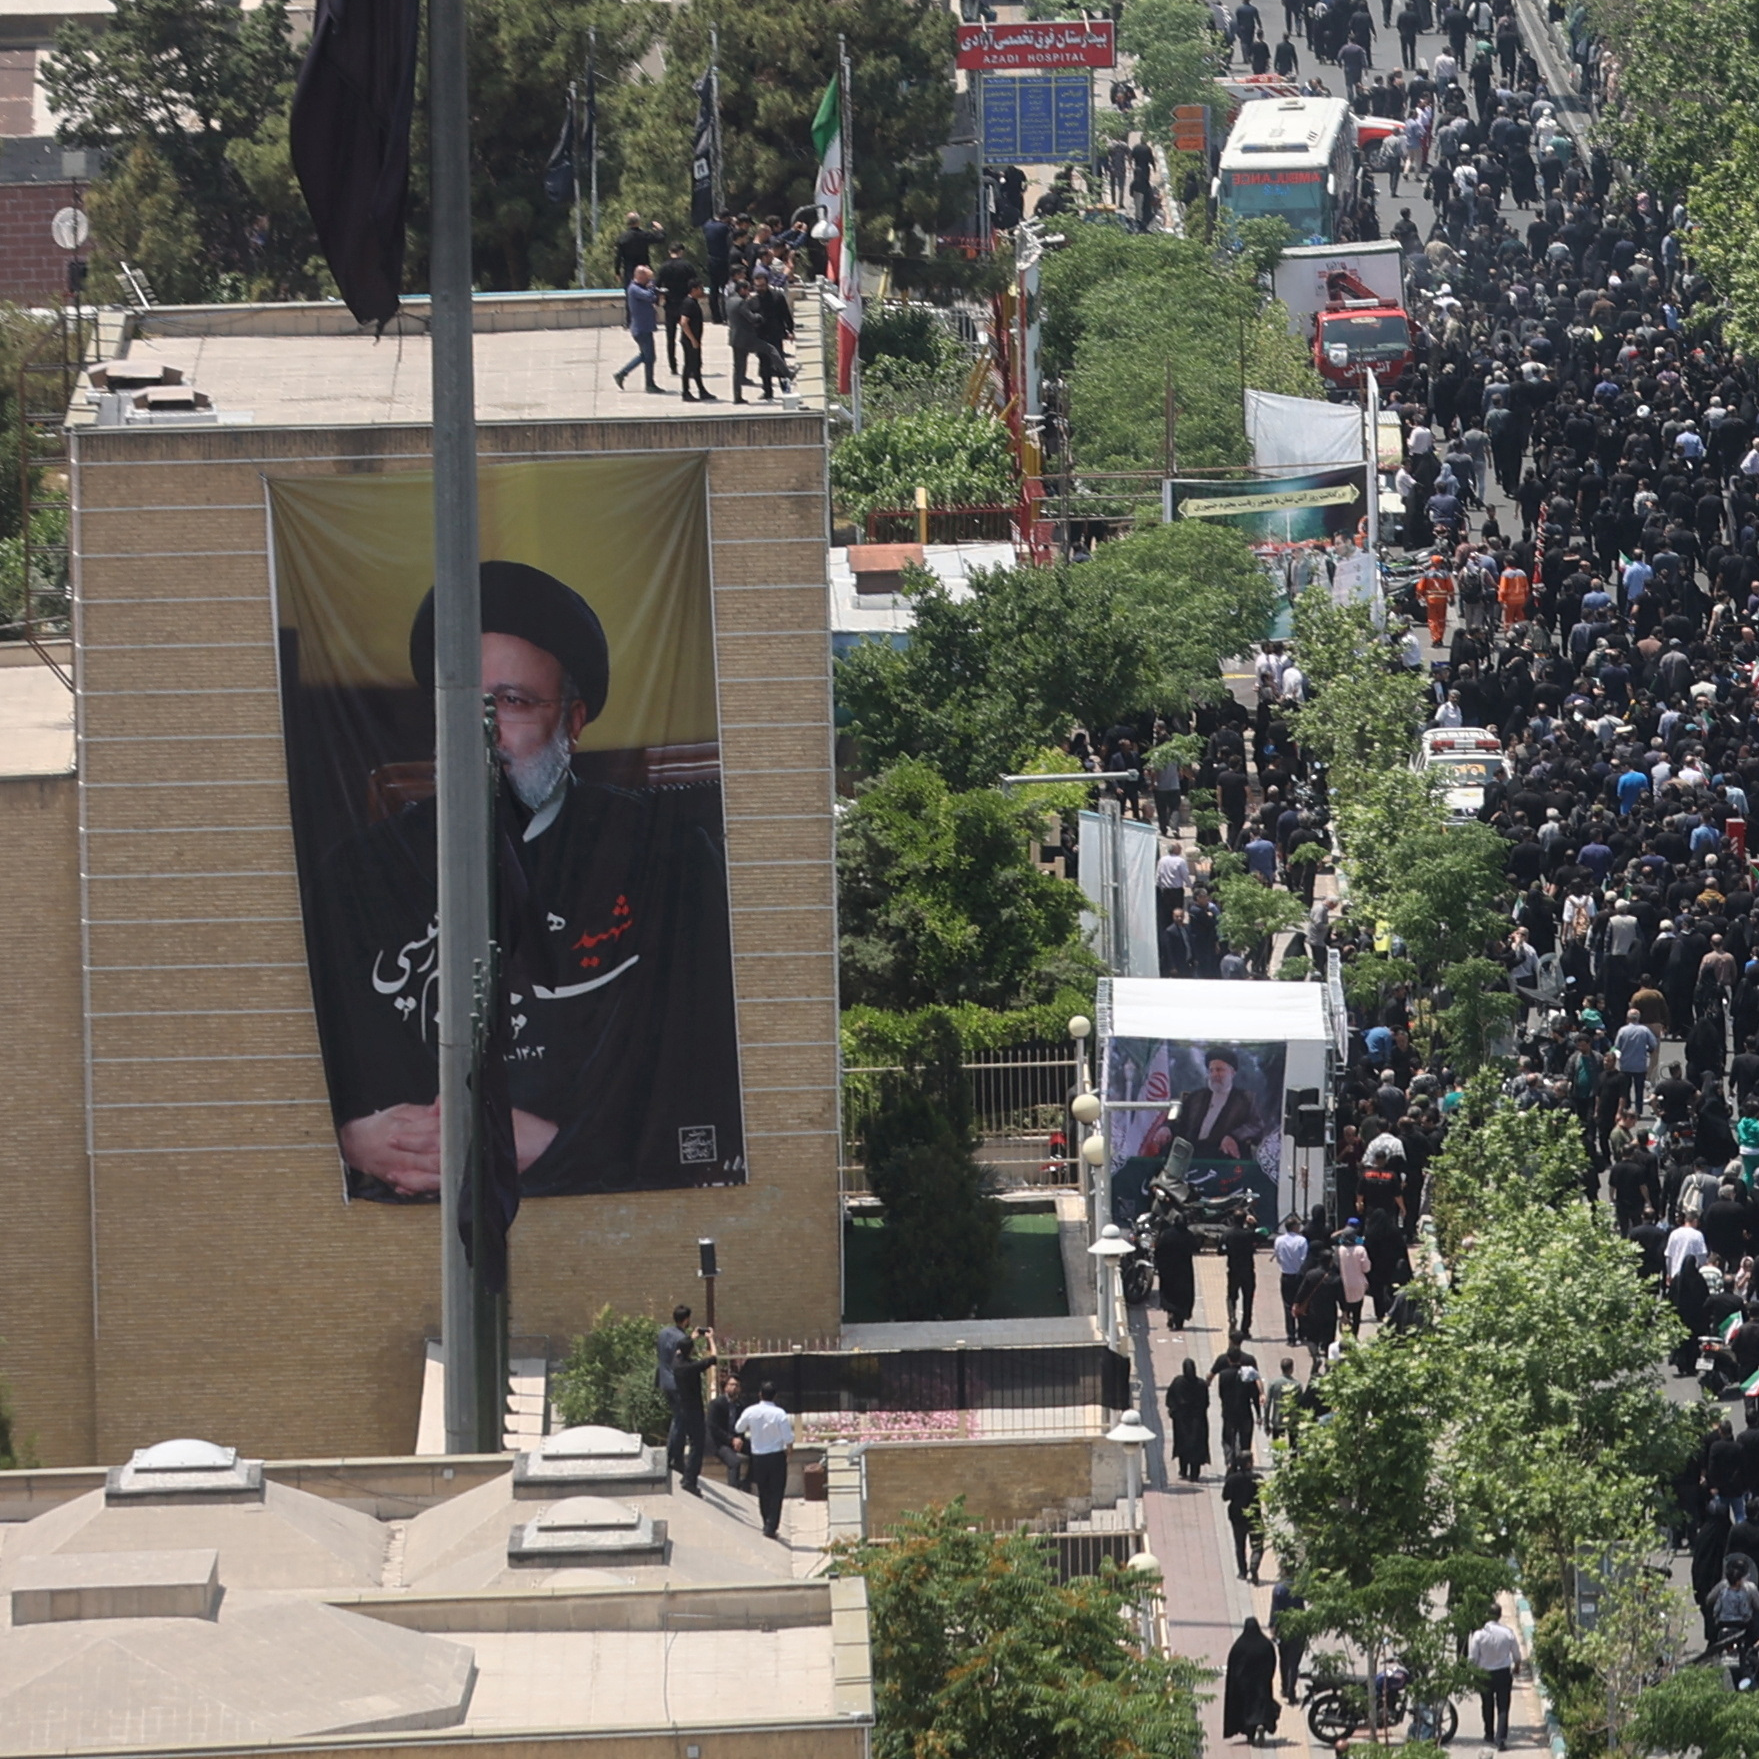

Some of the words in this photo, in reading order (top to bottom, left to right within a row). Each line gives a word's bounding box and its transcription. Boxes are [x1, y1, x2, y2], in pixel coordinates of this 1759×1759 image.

[994, 29, 1035, 51] تخصصی
[1034, 27, 1056, 49] فوق
[983, 53, 1020, 64] AZADI
[1027, 52, 1087, 63] HOSPITAL
[572, 895, 633, 968] شهید
